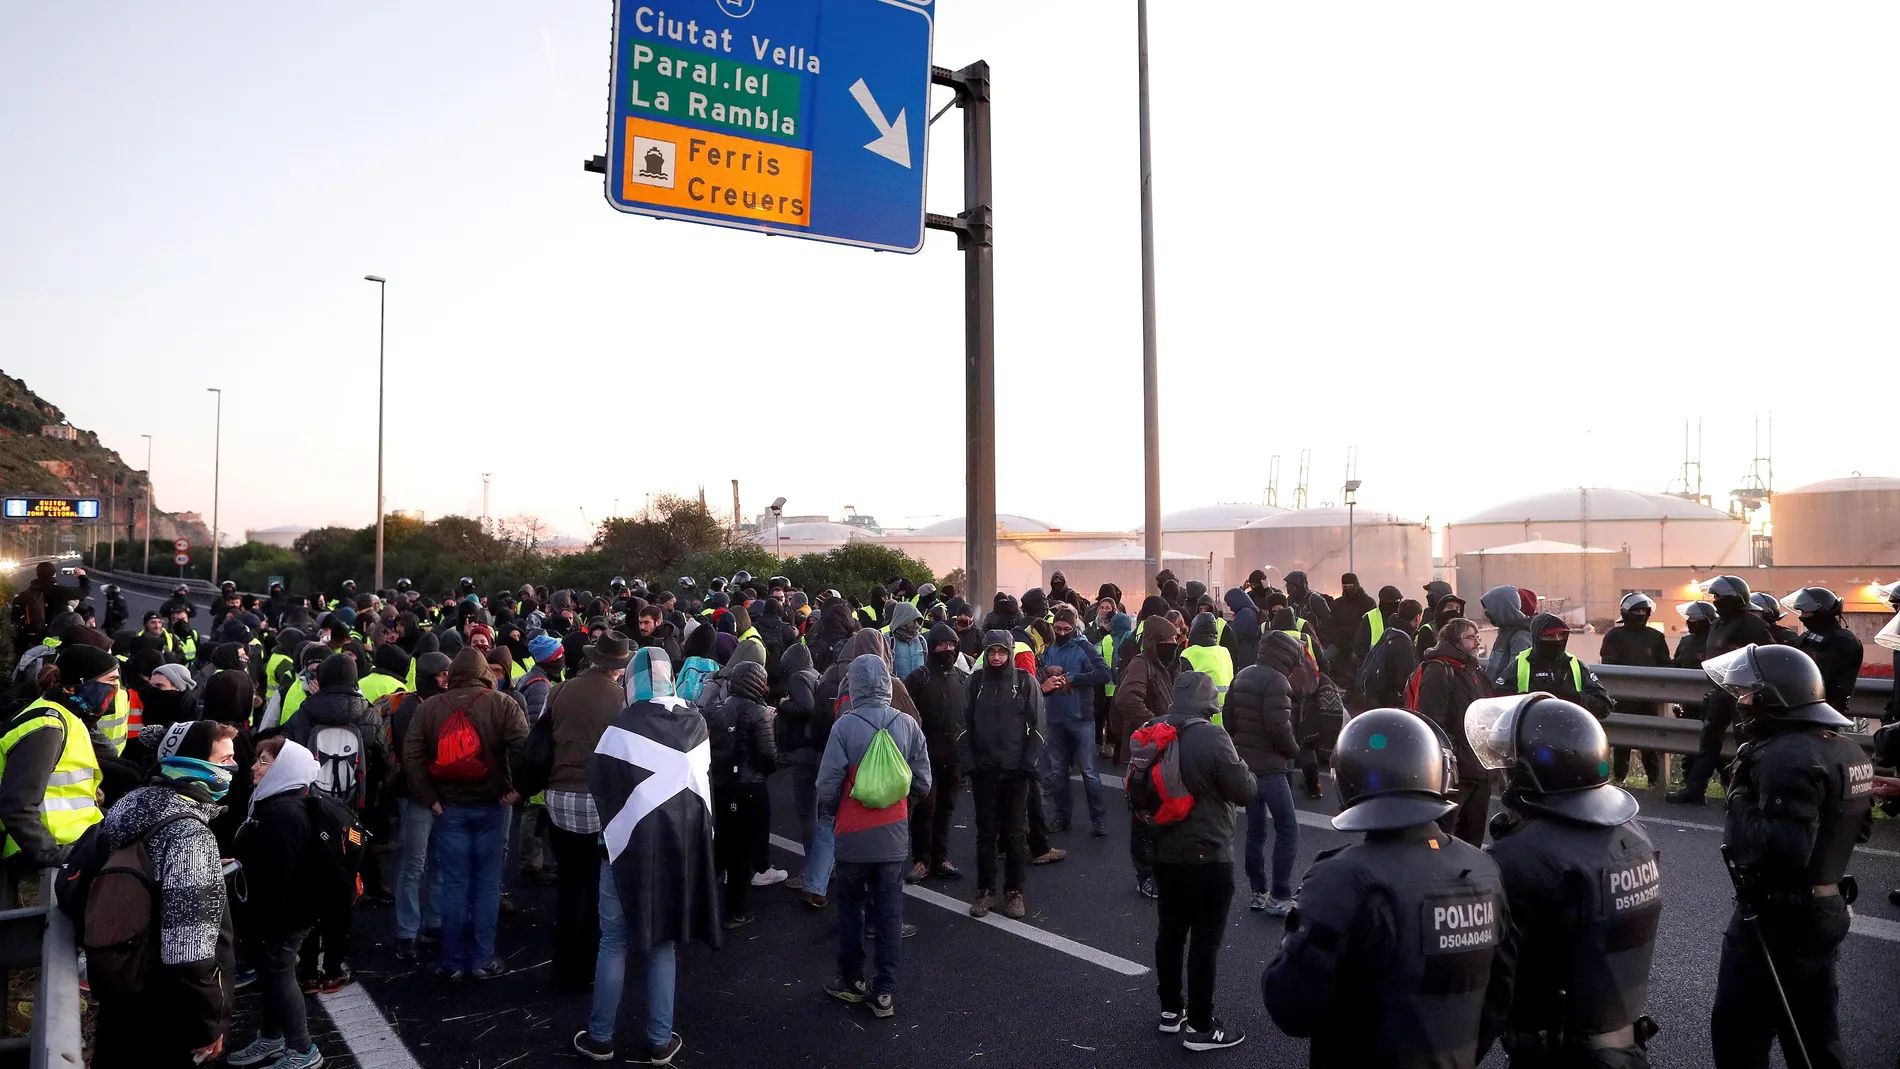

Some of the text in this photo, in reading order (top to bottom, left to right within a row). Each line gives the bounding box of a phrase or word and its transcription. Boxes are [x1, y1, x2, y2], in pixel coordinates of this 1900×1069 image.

[635, 7, 820, 74] Ciutat Vella
[633, 44, 768, 97] Paral.lel
[632, 80, 795, 136] La Rambla
[688, 138, 780, 176] Ferris
[687, 177, 804, 216] Creuers
[1610, 860, 1659, 893] POLICIA
[1434, 902, 1494, 930] POLICIA
[1440, 929, 1492, 949] D504A0494
[1212, 1030, 1224, 1041] N
